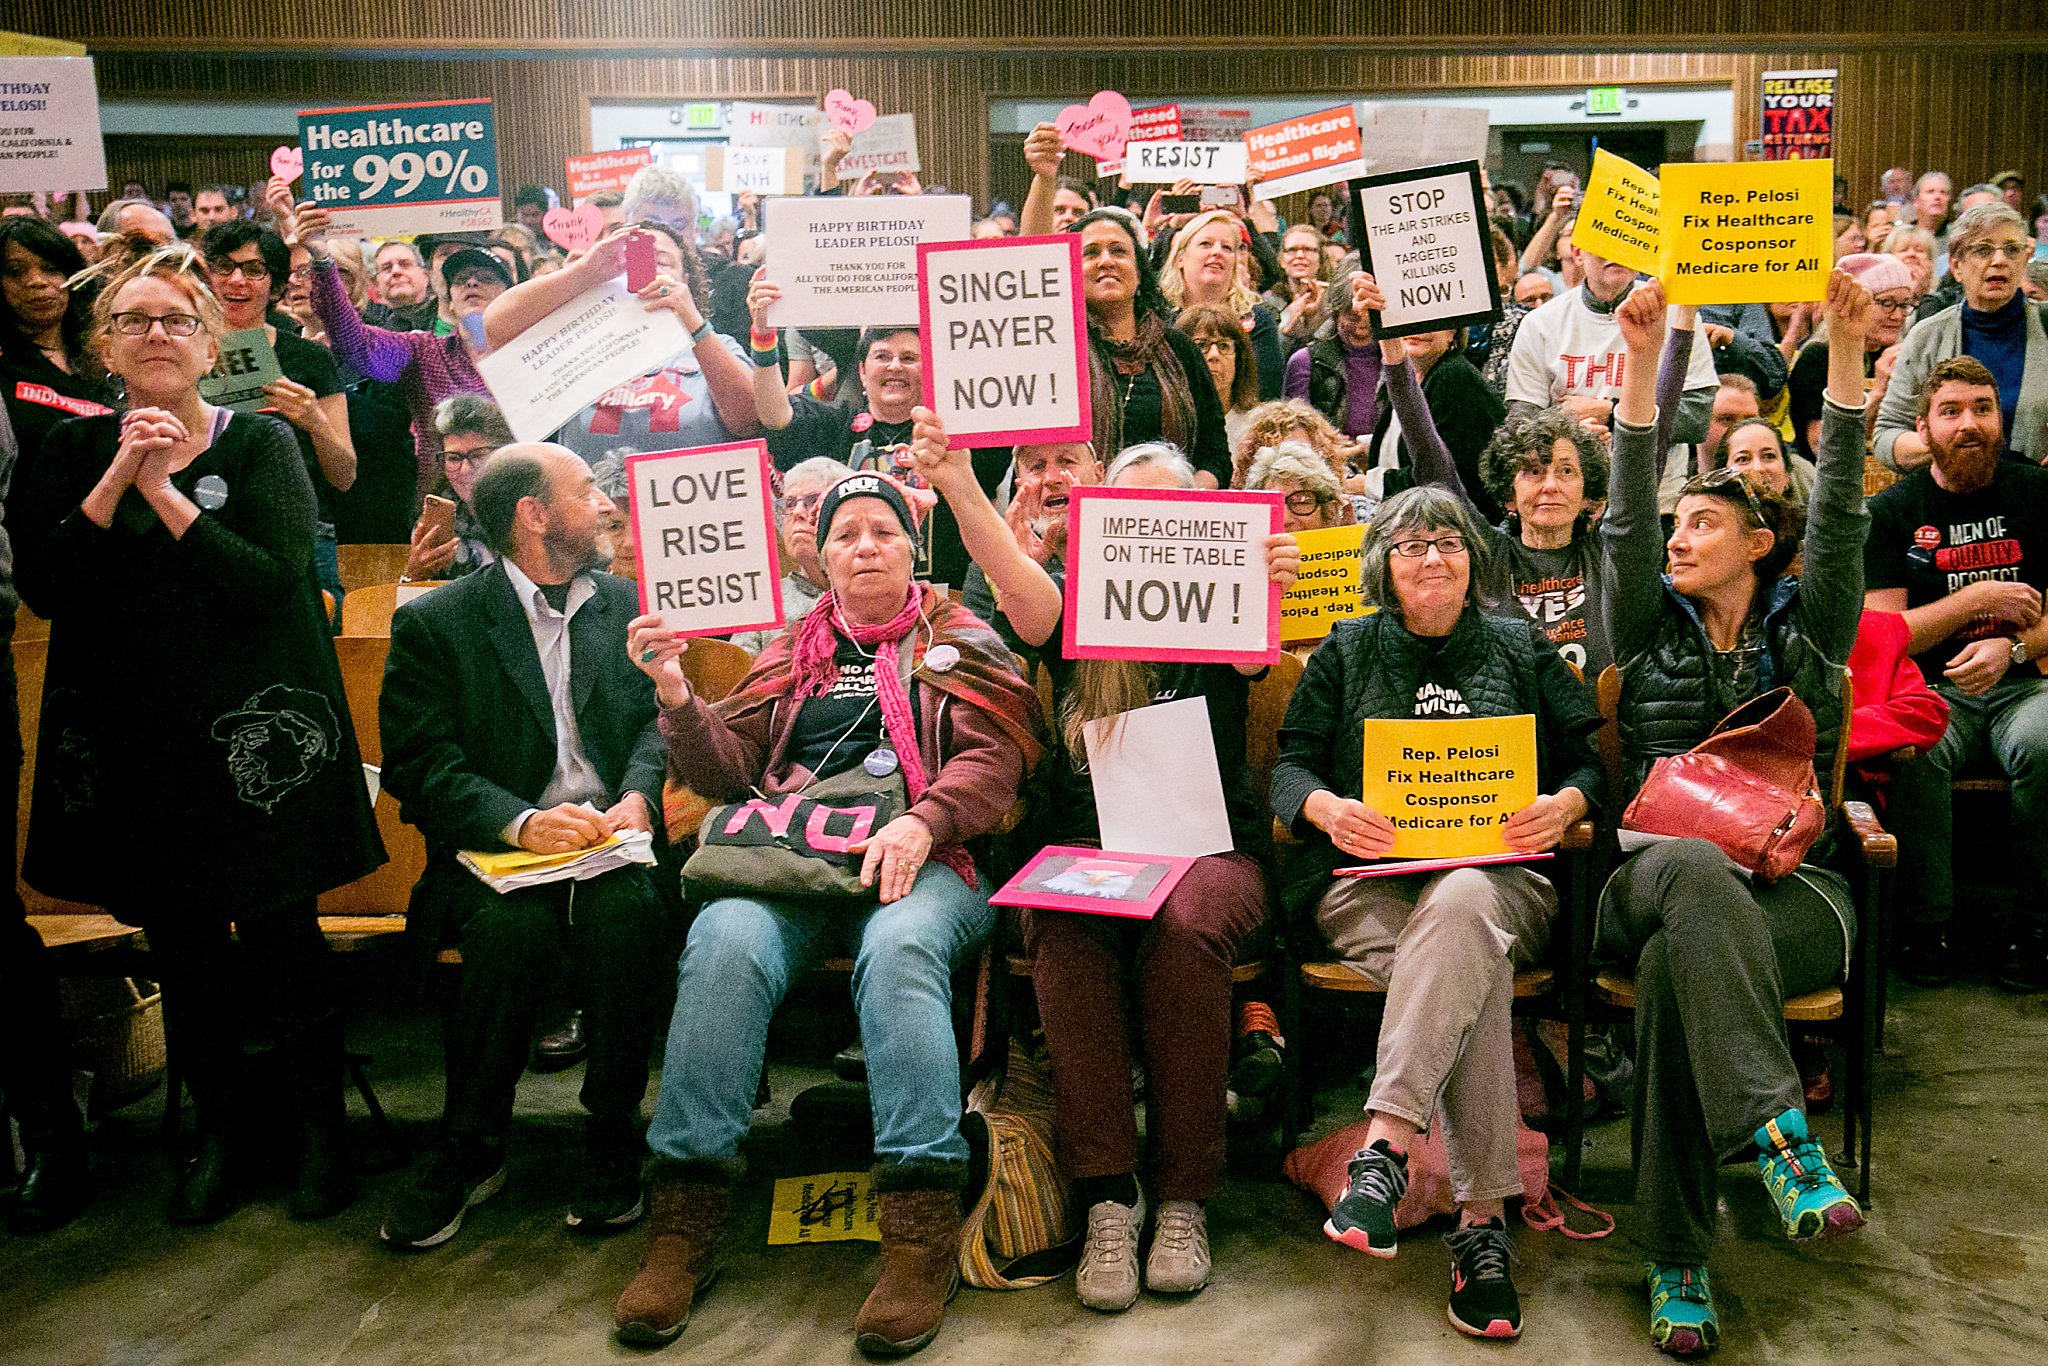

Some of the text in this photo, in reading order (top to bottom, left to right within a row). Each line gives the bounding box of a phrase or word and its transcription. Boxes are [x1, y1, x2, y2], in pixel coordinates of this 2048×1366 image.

[0, 83, 50, 94] THDAY
[1764, 79, 1833, 94] RELEASE
[2, 100, 47, 111] ELOSI!
[1764, 95, 1833, 109] YOUR
[1131, 107, 1177, 125] nteed
[1764, 108, 1830, 132] TAX
[307, 118, 484, 151] Healthcare
[1128, 123, 1179, 140] thcare
[1250, 116, 1351, 151] Healthcare
[1142, 146, 1220, 168] RESIST
[1254, 152, 1310, 172] Human
[1312, 140, 1356, 161] Right
[311, 161, 345, 180] for
[313, 149, 489, 201] the 99%
[735, 172, 770, 187] NIH
[1607, 187, 1626, 203] Fix
[1621, 178, 1648, 196] Rep.
[1389, 188, 1445, 215] STOP
[1700, 188, 1799, 208] Rep. Pelosi
[809, 220, 925, 233] HAPPY BIRTHDAY
[1372, 211, 1471, 237] THE AIR STRIKES
[1683, 212, 1814, 228] Fix Healthcare
[815, 238, 866, 249] LEADER
[1411, 232, 1436, 247] AND
[1591, 218, 1650, 250] Medicare
[1395, 245, 1458, 265] TARGETED
[1702, 237, 1796, 255] Cosponsor
[830, 262, 906, 271] THANK YOU FOR
[1402, 261, 1456, 280] KILLINGS
[1676, 258, 1819, 275] Medicare for All
[795, 273, 918, 283] ALL YOU DO FOR CALIFOR
[939, 268, 1060, 304] SINGLE
[813, 284, 918, 294] THE AMERICAN PEOPL
[1400, 285, 1452, 308] NOW
[521, 294, 616, 363] HAPPY BIRTHDAY
[949, 315, 1056, 350] PAYER
[591, 328, 641, 360] CALIFORNIA
[212, 347, 260, 378] EE
[532, 337, 574, 371] LEADER
[1560, 353, 1626, 388] THI
[599, 385, 676, 410] Hillary
[954, 374, 1036, 410] NOW
[650, 468, 748, 508] LOVE
[838, 476, 880, 498] NO!
[1103, 517, 1247, 539] IMPEACHMENT
[1950, 516, 2007, 545] MEN OF
[662, 520, 745, 558] RISE
[1103, 544, 1246, 566] ON THE TABLE
[1950, 541, 2012, 568] QUALITY
[1296, 568, 1348, 580] Cospon
[655, 571, 761, 611] RESIST
[1281, 587, 1339, 600] Healthc
[1520, 576, 1583, 594] healthcare
[1104, 579, 1216, 624] NOW
[1281, 603, 1354, 618] Rep. Pelos
[1549, 627, 1587, 643] panies
[840, 664, 862, 675] NO
[1414, 697, 1471, 715] IVILIA
[1402, 745, 1499, 763] Rep. Pelosi
[1387, 769, 1515, 783] Fix Healthcare
[1405, 793, 1498, 809] Cosponsor
[724, 793, 877, 853] NO
[1385, 815, 1464, 829] Medicare
[1469, 814, 1493, 826] for
